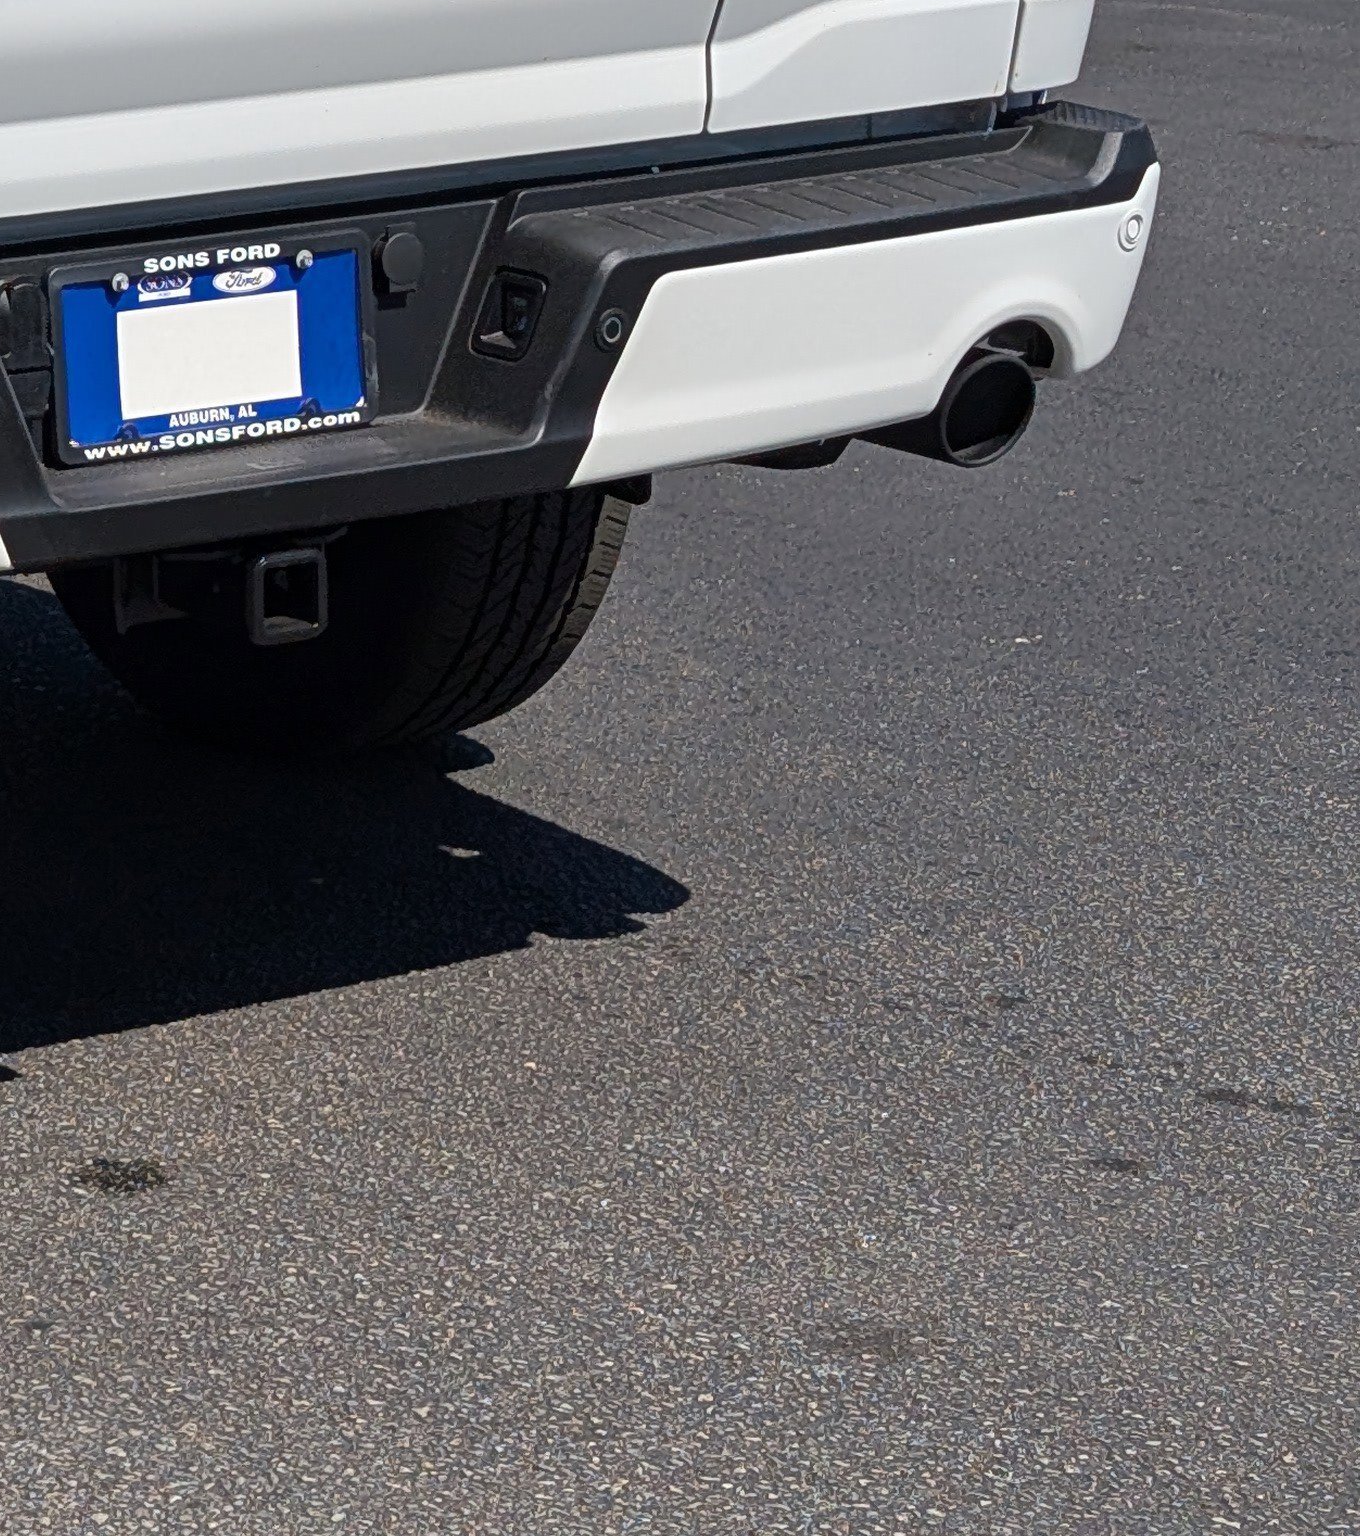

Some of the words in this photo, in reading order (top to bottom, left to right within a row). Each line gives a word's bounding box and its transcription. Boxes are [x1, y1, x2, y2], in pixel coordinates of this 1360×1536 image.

[143, 251, 210, 273] SONS
[217, 243, 281, 265] FORD
[168, 408, 235, 428] AUBURN,
[238, 404, 257, 418] AL
[84, 410, 361, 461] www.SONSFORD.com
